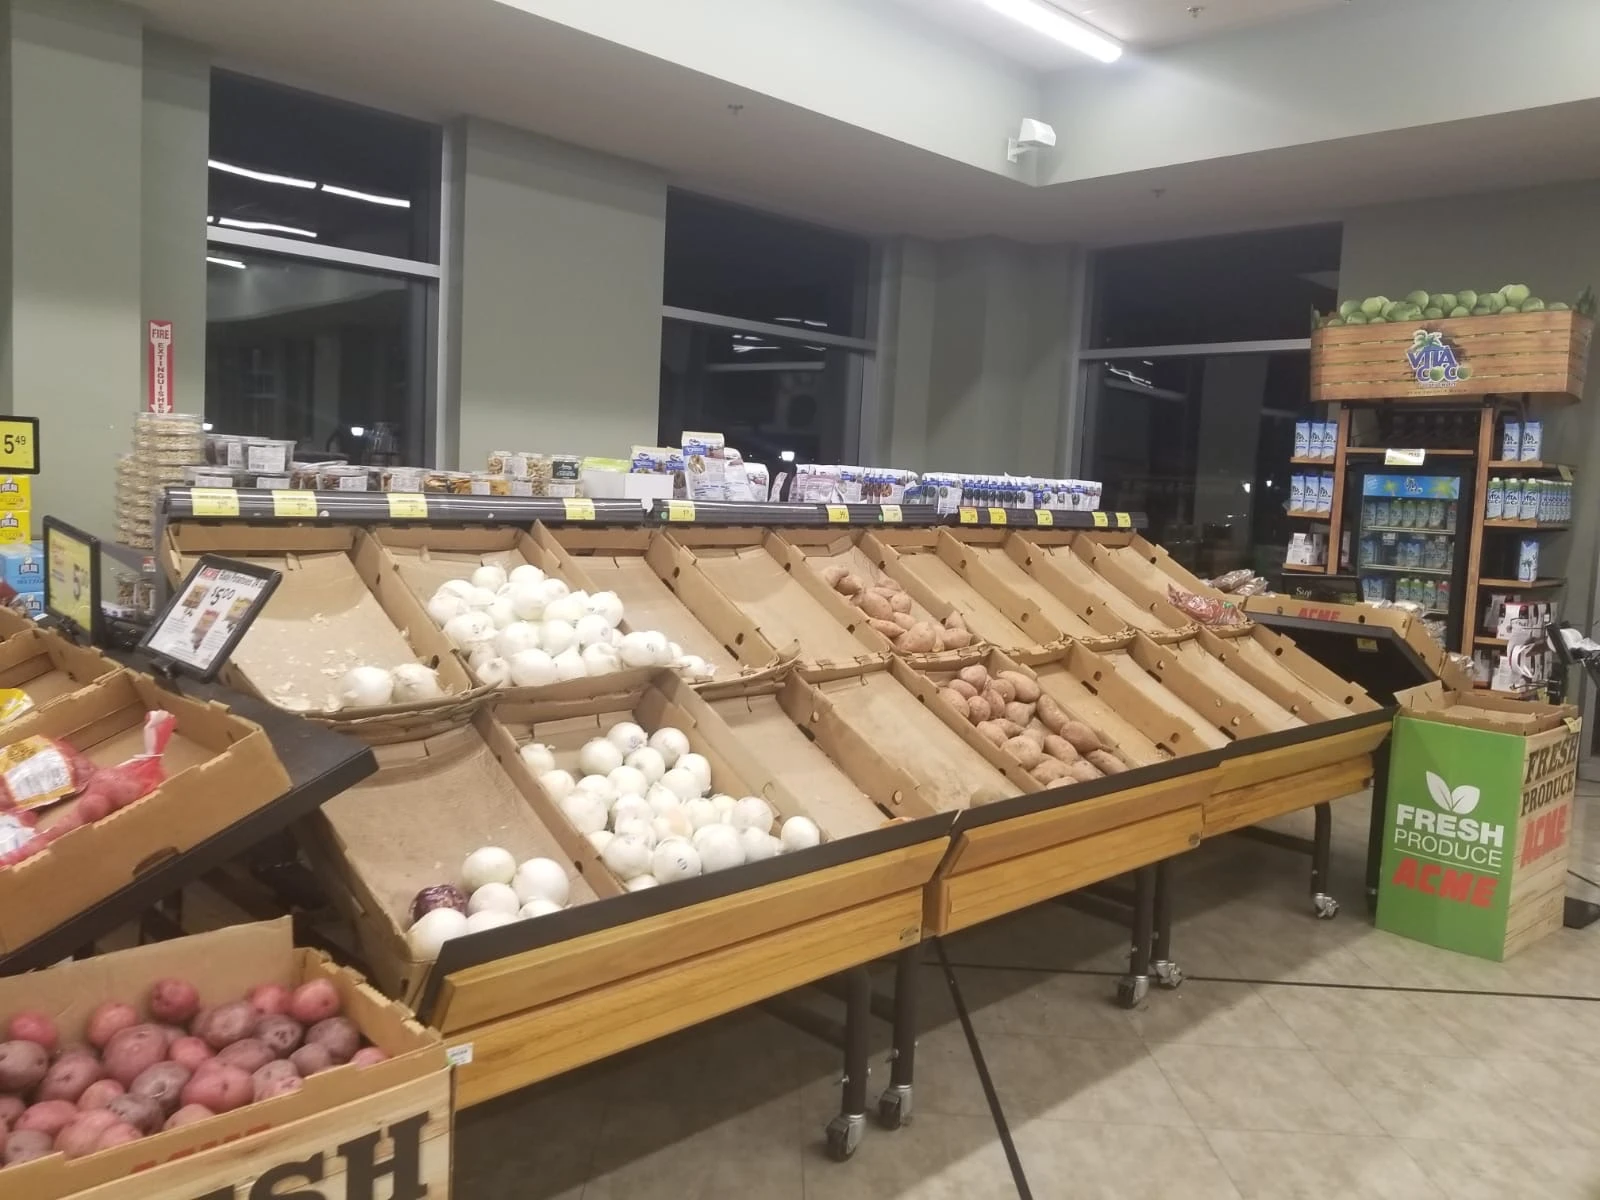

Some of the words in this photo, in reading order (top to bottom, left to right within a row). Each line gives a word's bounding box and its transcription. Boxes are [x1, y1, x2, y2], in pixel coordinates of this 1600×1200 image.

[152, 329, 169, 339] FIRE
[1524, 735, 1580, 784] FRESH
[1520, 770, 1575, 816] PRODUCE
[1394, 829, 1503, 868] PRODUCE
[1396, 804, 1504, 847] FRESH
[1520, 804, 1568, 868] ACME
[1392, 857, 1498, 908] ACME
